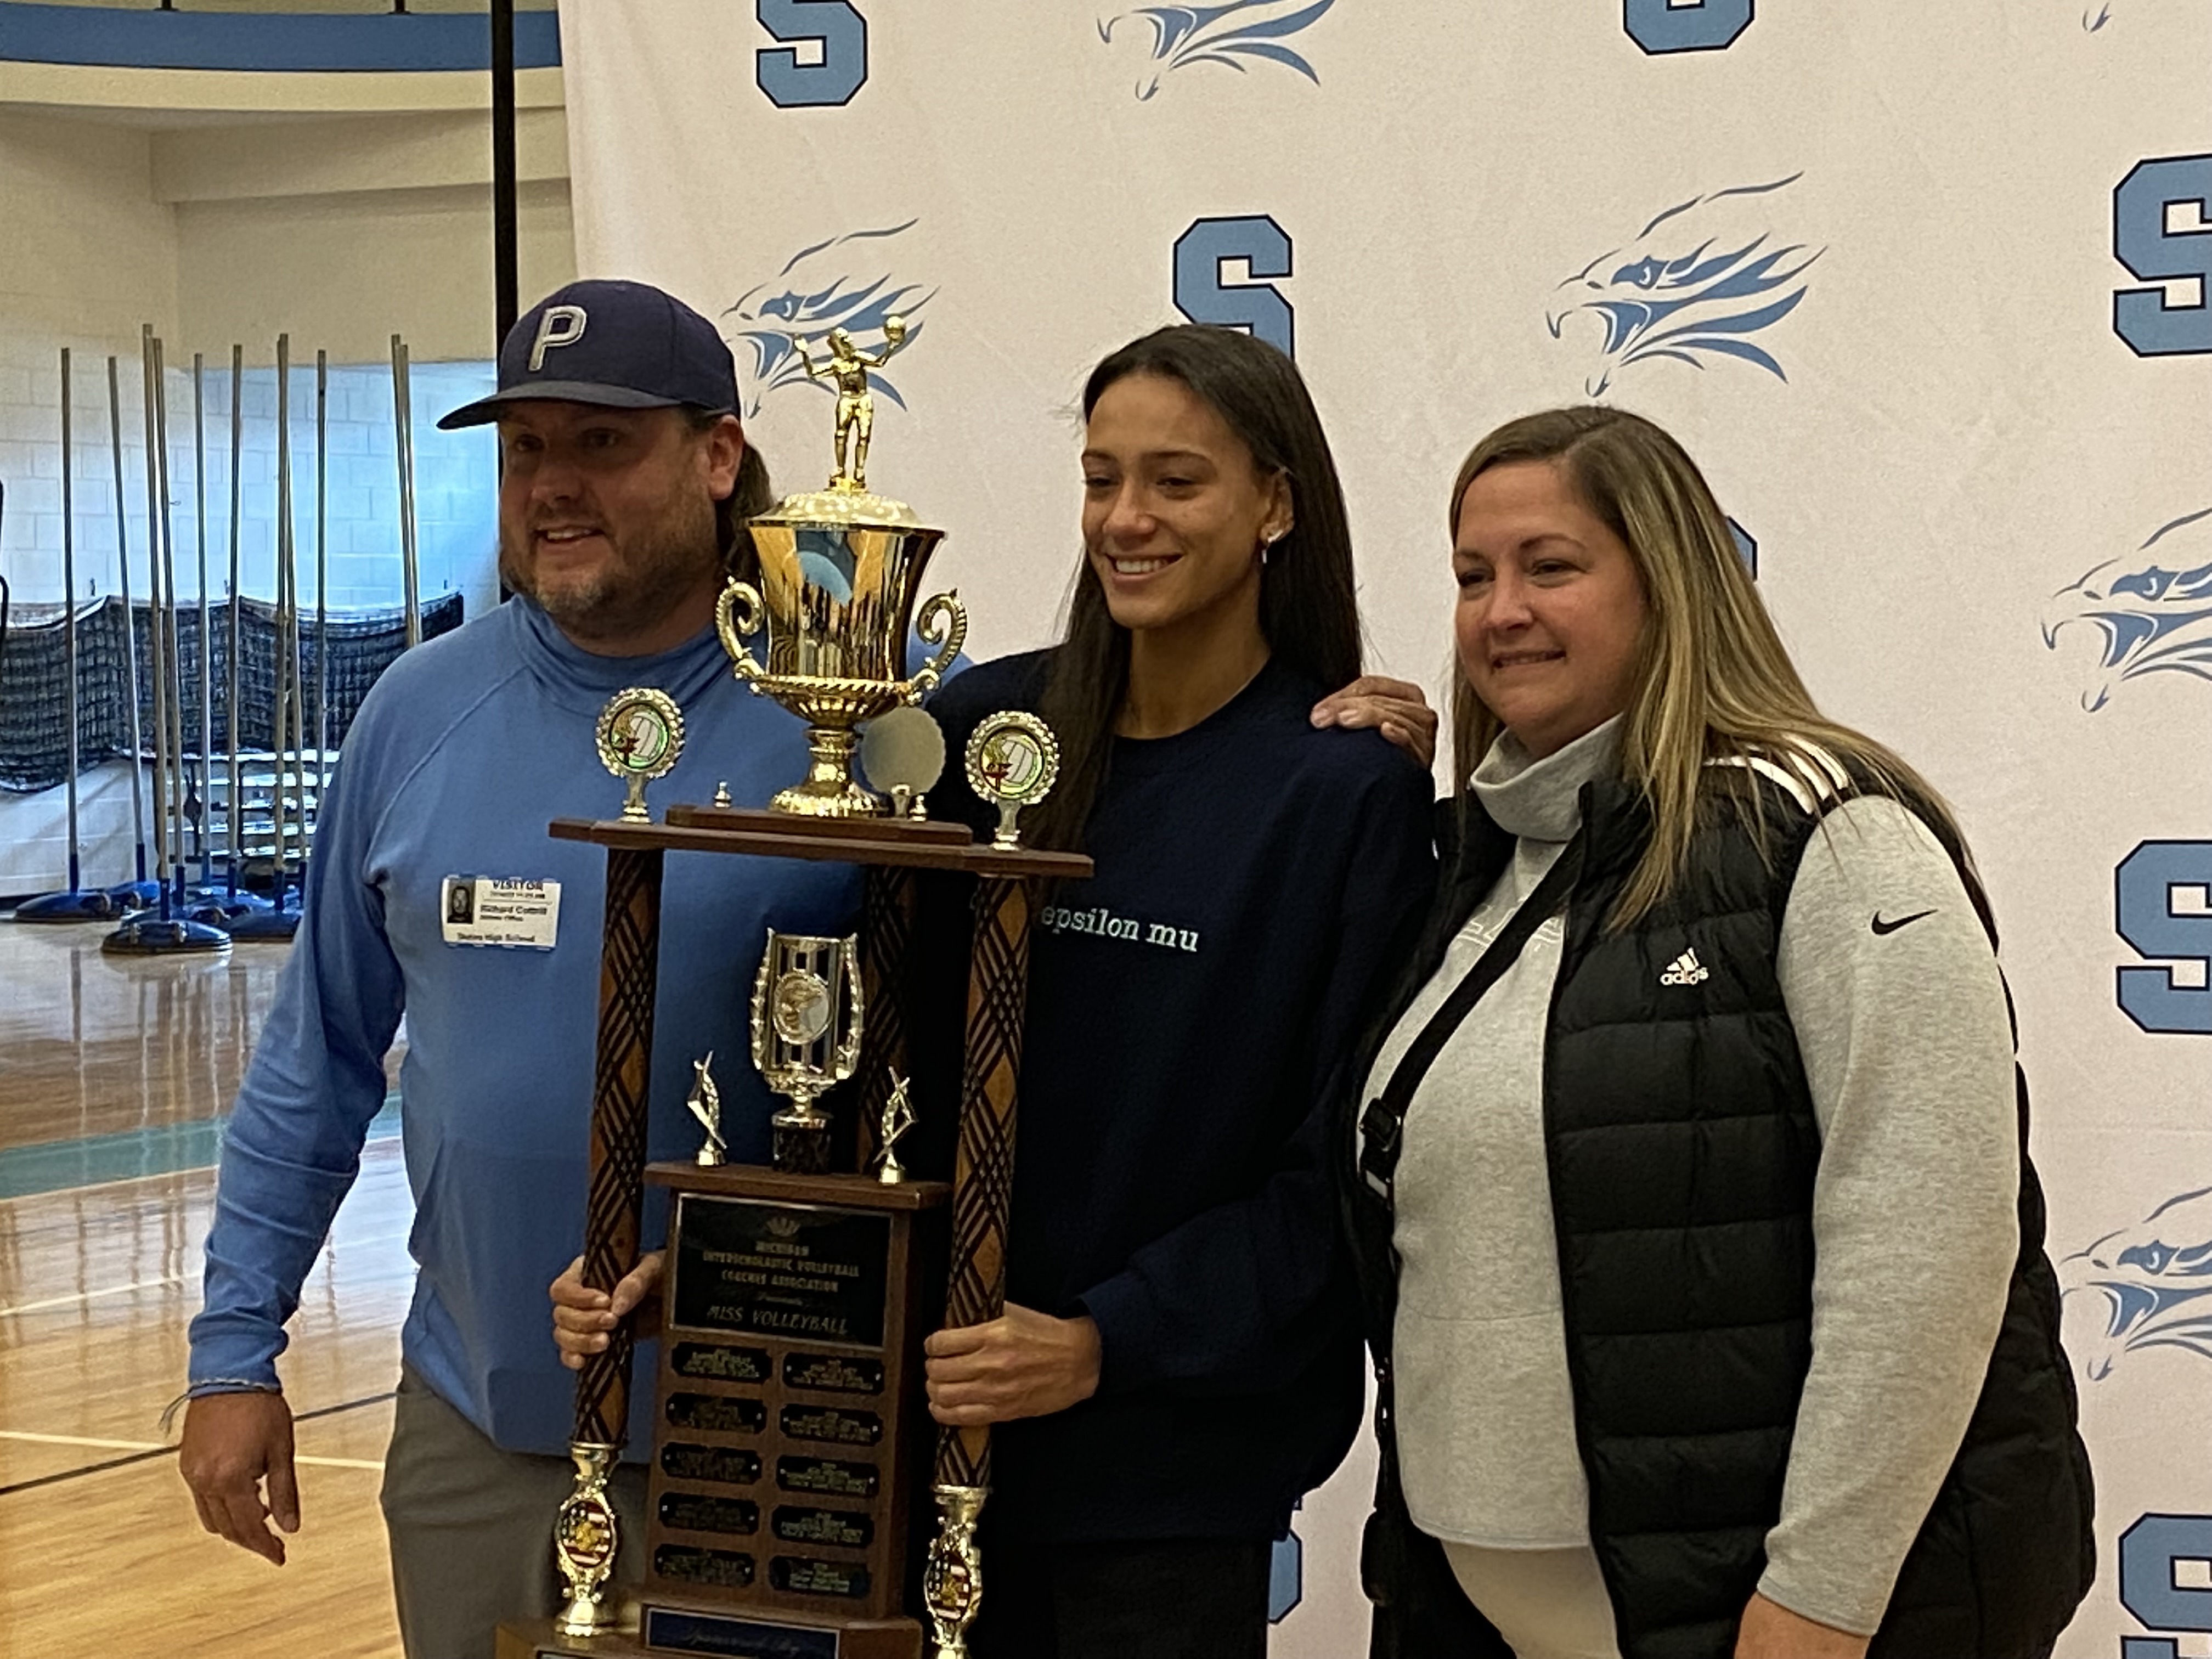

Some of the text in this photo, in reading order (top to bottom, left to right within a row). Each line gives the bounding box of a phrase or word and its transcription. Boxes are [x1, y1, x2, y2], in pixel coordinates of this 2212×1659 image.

[756, 0, 868, 108] S
[1173, 215, 1295, 362] S
[2113, 154, 2212, 358] S
[528, 304, 587, 371] P
[492, 879, 544, 891] VISITOR
[1042, 906, 1199, 952] epsilon mu
[2114, 839, 2212, 1035] S
[707, 1305, 849, 1335] MISS VOLLEYBALL
